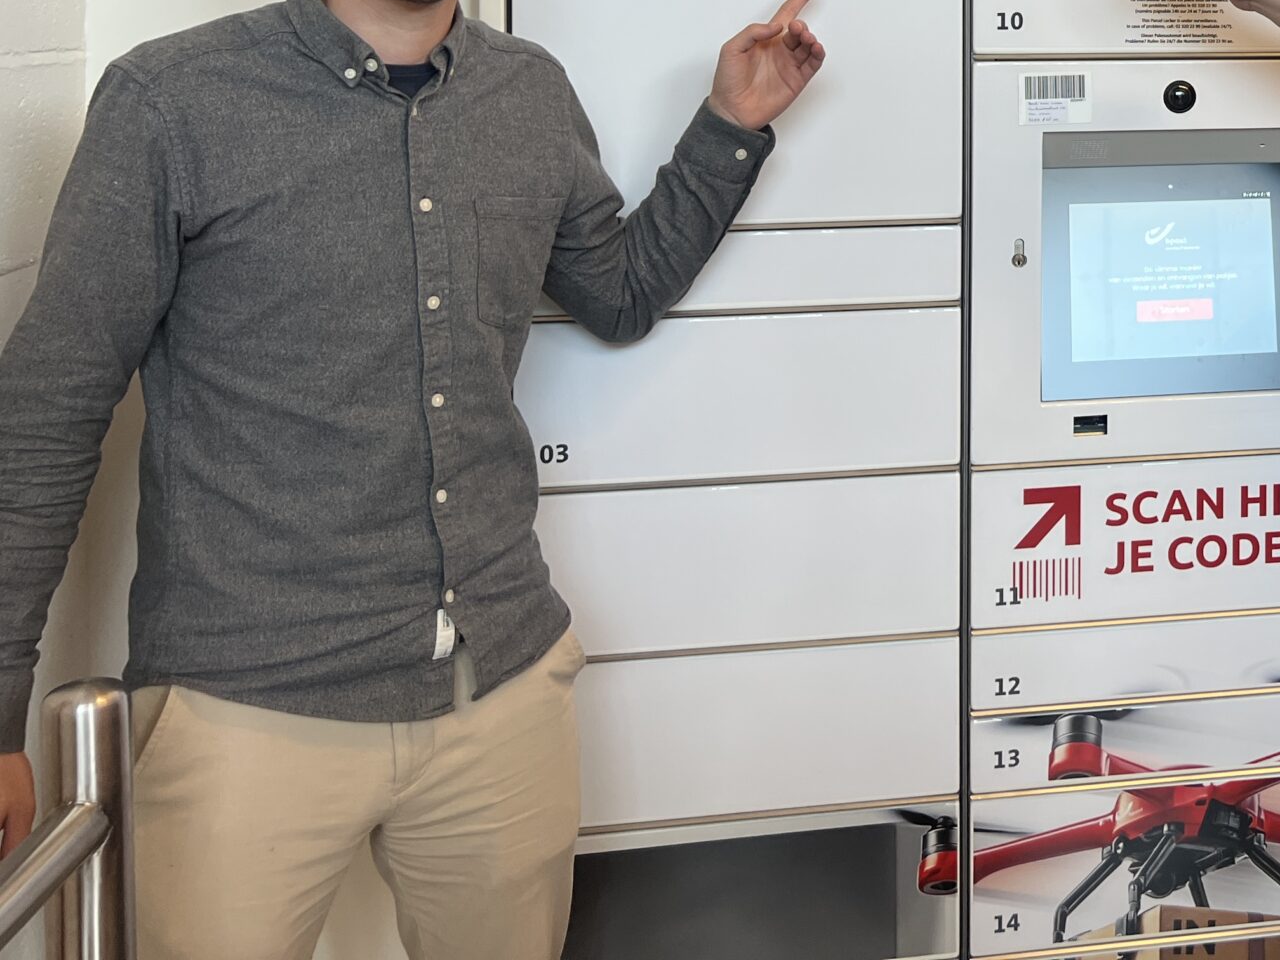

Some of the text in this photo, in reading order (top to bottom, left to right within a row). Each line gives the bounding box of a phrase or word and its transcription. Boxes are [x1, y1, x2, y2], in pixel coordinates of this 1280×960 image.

[996, 11, 1024, 30] 10
[539, 444, 568, 463] 03
[1105, 487, 1225, 527] SCAN
[1104, 539, 1154, 575] JE
[995, 587, 1021, 606] 11
[994, 677, 1021, 696] 12
[994, 750, 1020, 768] 13
[994, 914, 1020, 933] 14
